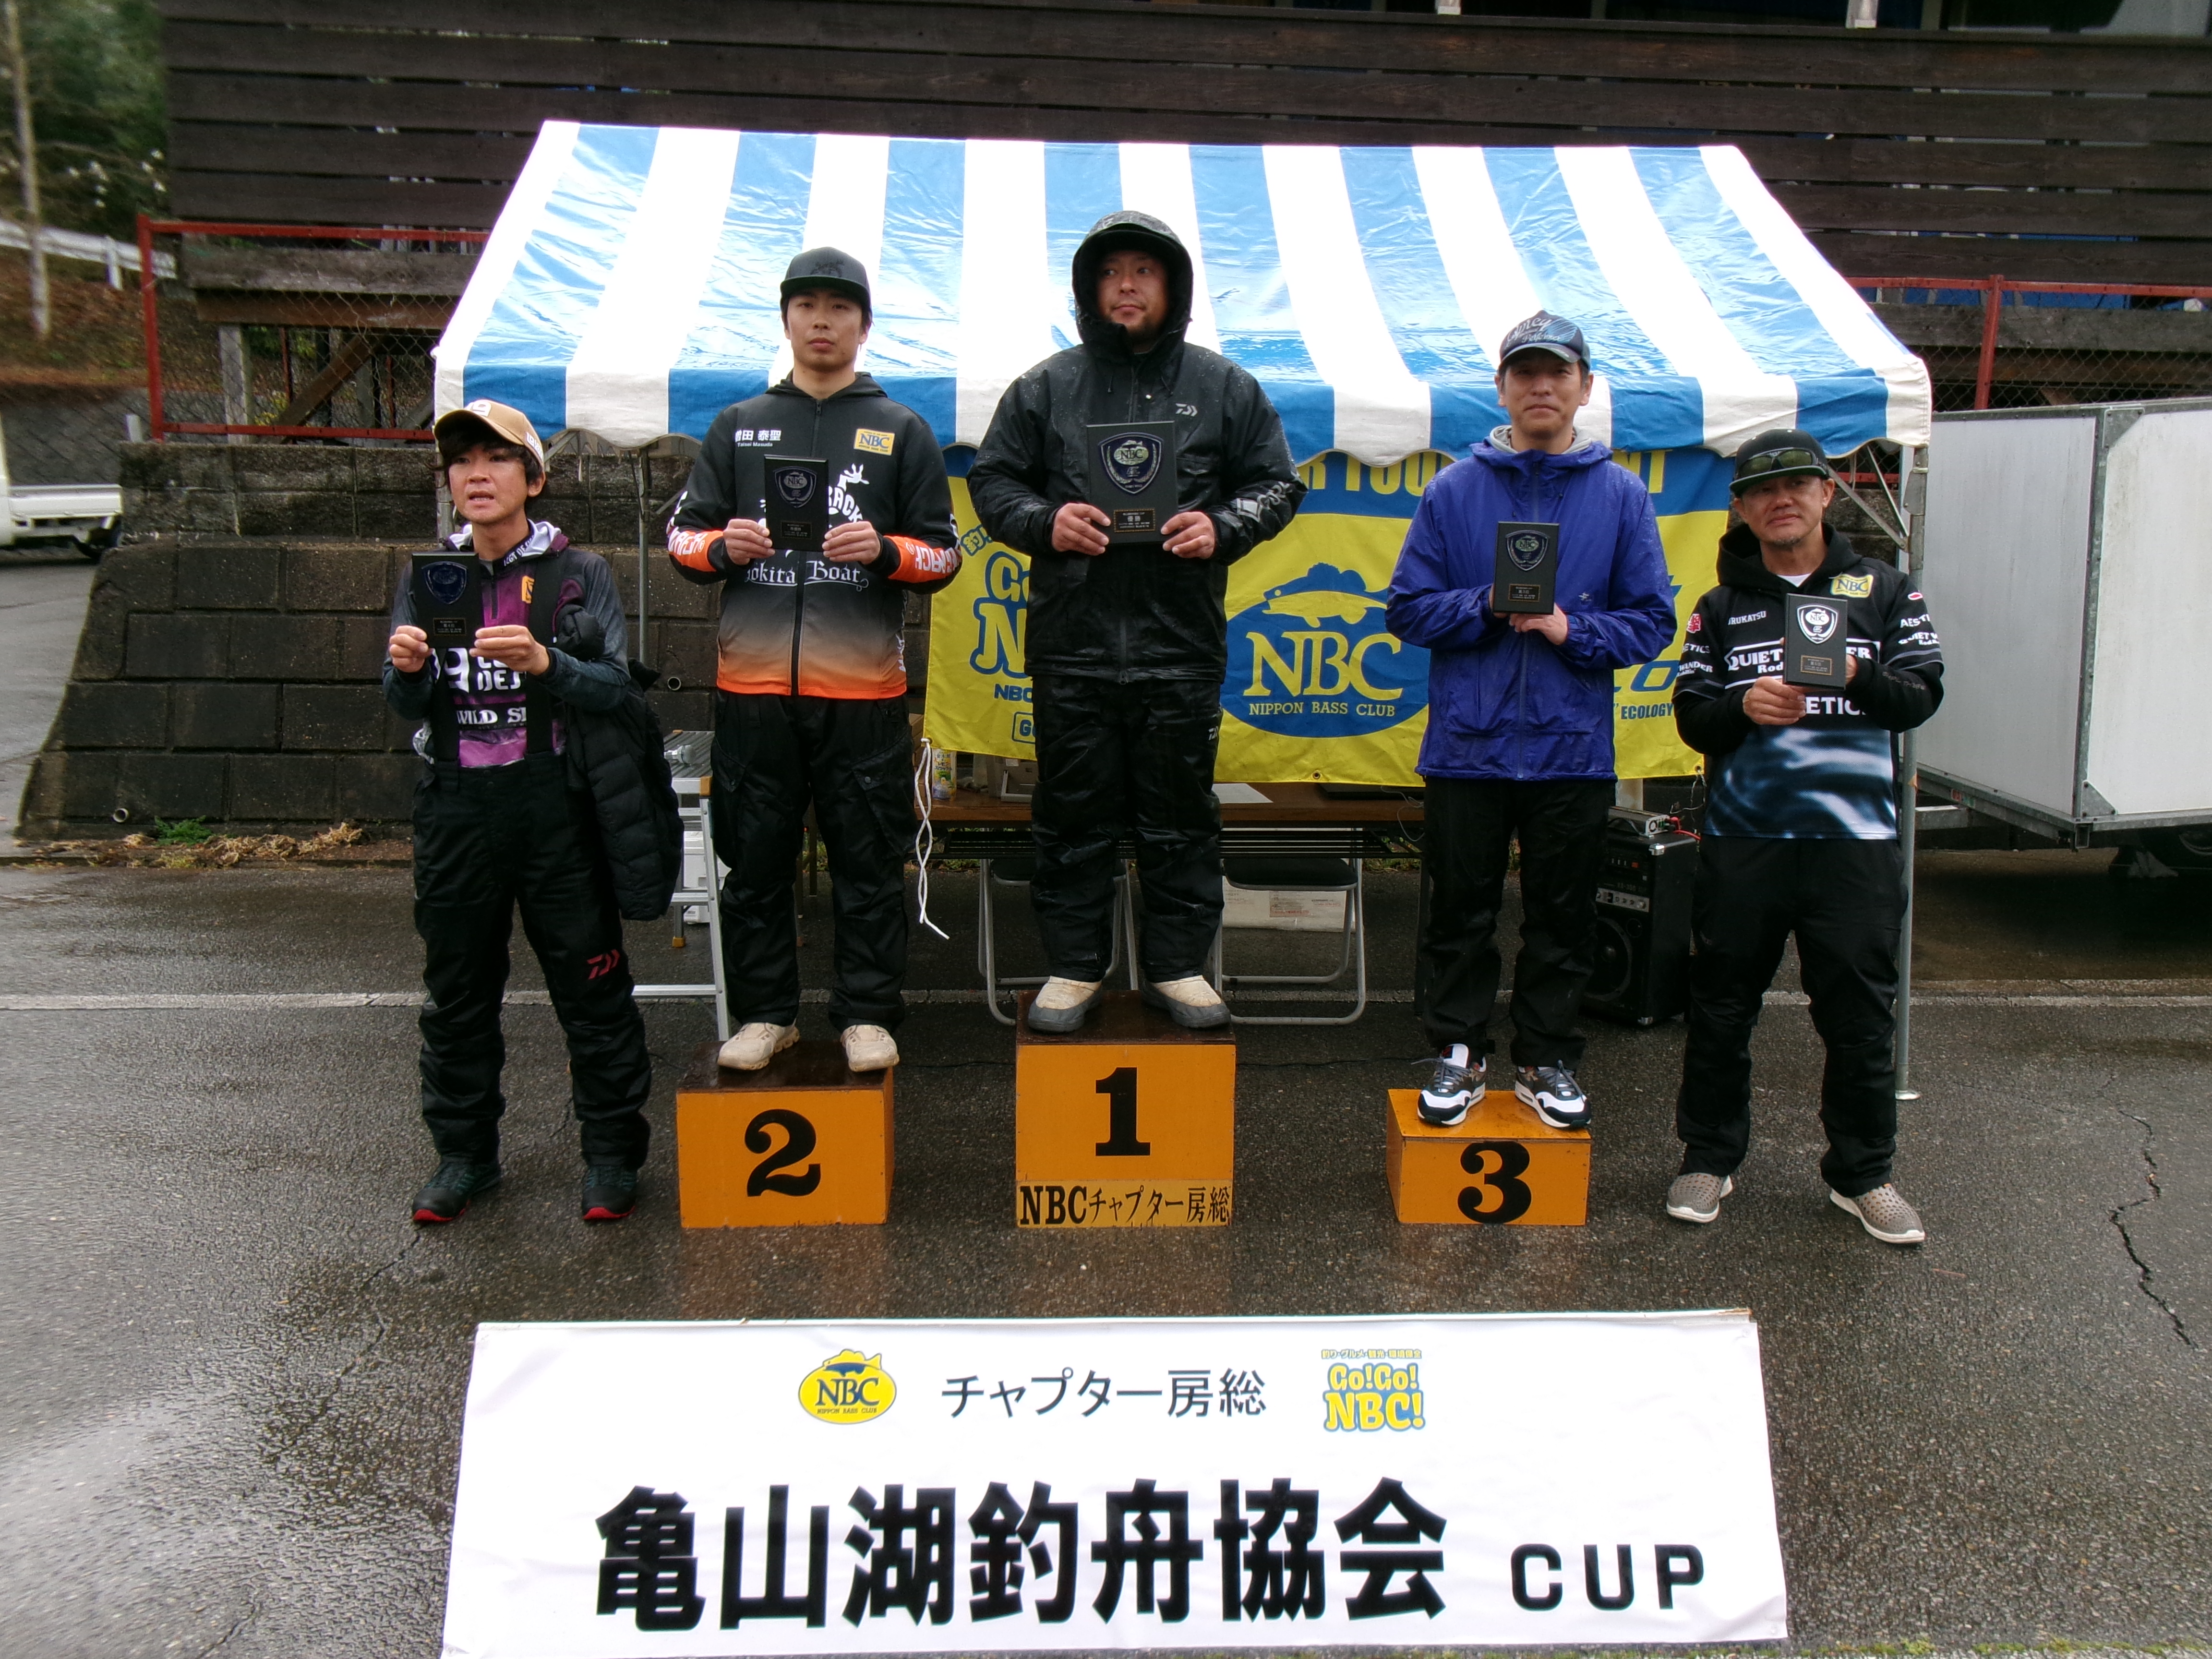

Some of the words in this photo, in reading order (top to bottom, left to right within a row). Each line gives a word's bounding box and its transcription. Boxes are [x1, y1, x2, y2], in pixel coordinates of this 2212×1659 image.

[859, 433, 890, 448] NBC
[1120, 449, 1143, 460] NBC
[787, 476, 805, 486] NBC
[805, 560, 862, 584] Boat
[1836, 579, 1868, 592] NBC
[1810, 614, 1825, 623] NBC
[1243, 631, 1403, 701] NBC
[1728, 648, 1783, 671] QUIET
[457, 709, 498, 725] WILD
[1248, 702, 1304, 716] NIPPON
[1311, 701, 1348, 715] BASS
[1356, 703, 1395, 717] CLUB
[1621, 702, 1674, 720] ECOLOGY
[1095, 1067, 1151, 1156] 1
[745, 1109, 821, 1197] 2
[1457, 1141, 1531, 1224] 3
[1020, 1185, 1230, 1225] NBCチャプター房総
[1329, 1364, 1418, 1391] Go!Go!
[815, 1377, 880, 1407] NBC
[942, 1367, 1266, 1418] チャプター房総
[1324, 1391, 1425, 1431] NBC!
[595, 1477, 1448, 1632] 亀山湖釣舟協会
[1511, 1543, 1704, 1611] CUP
